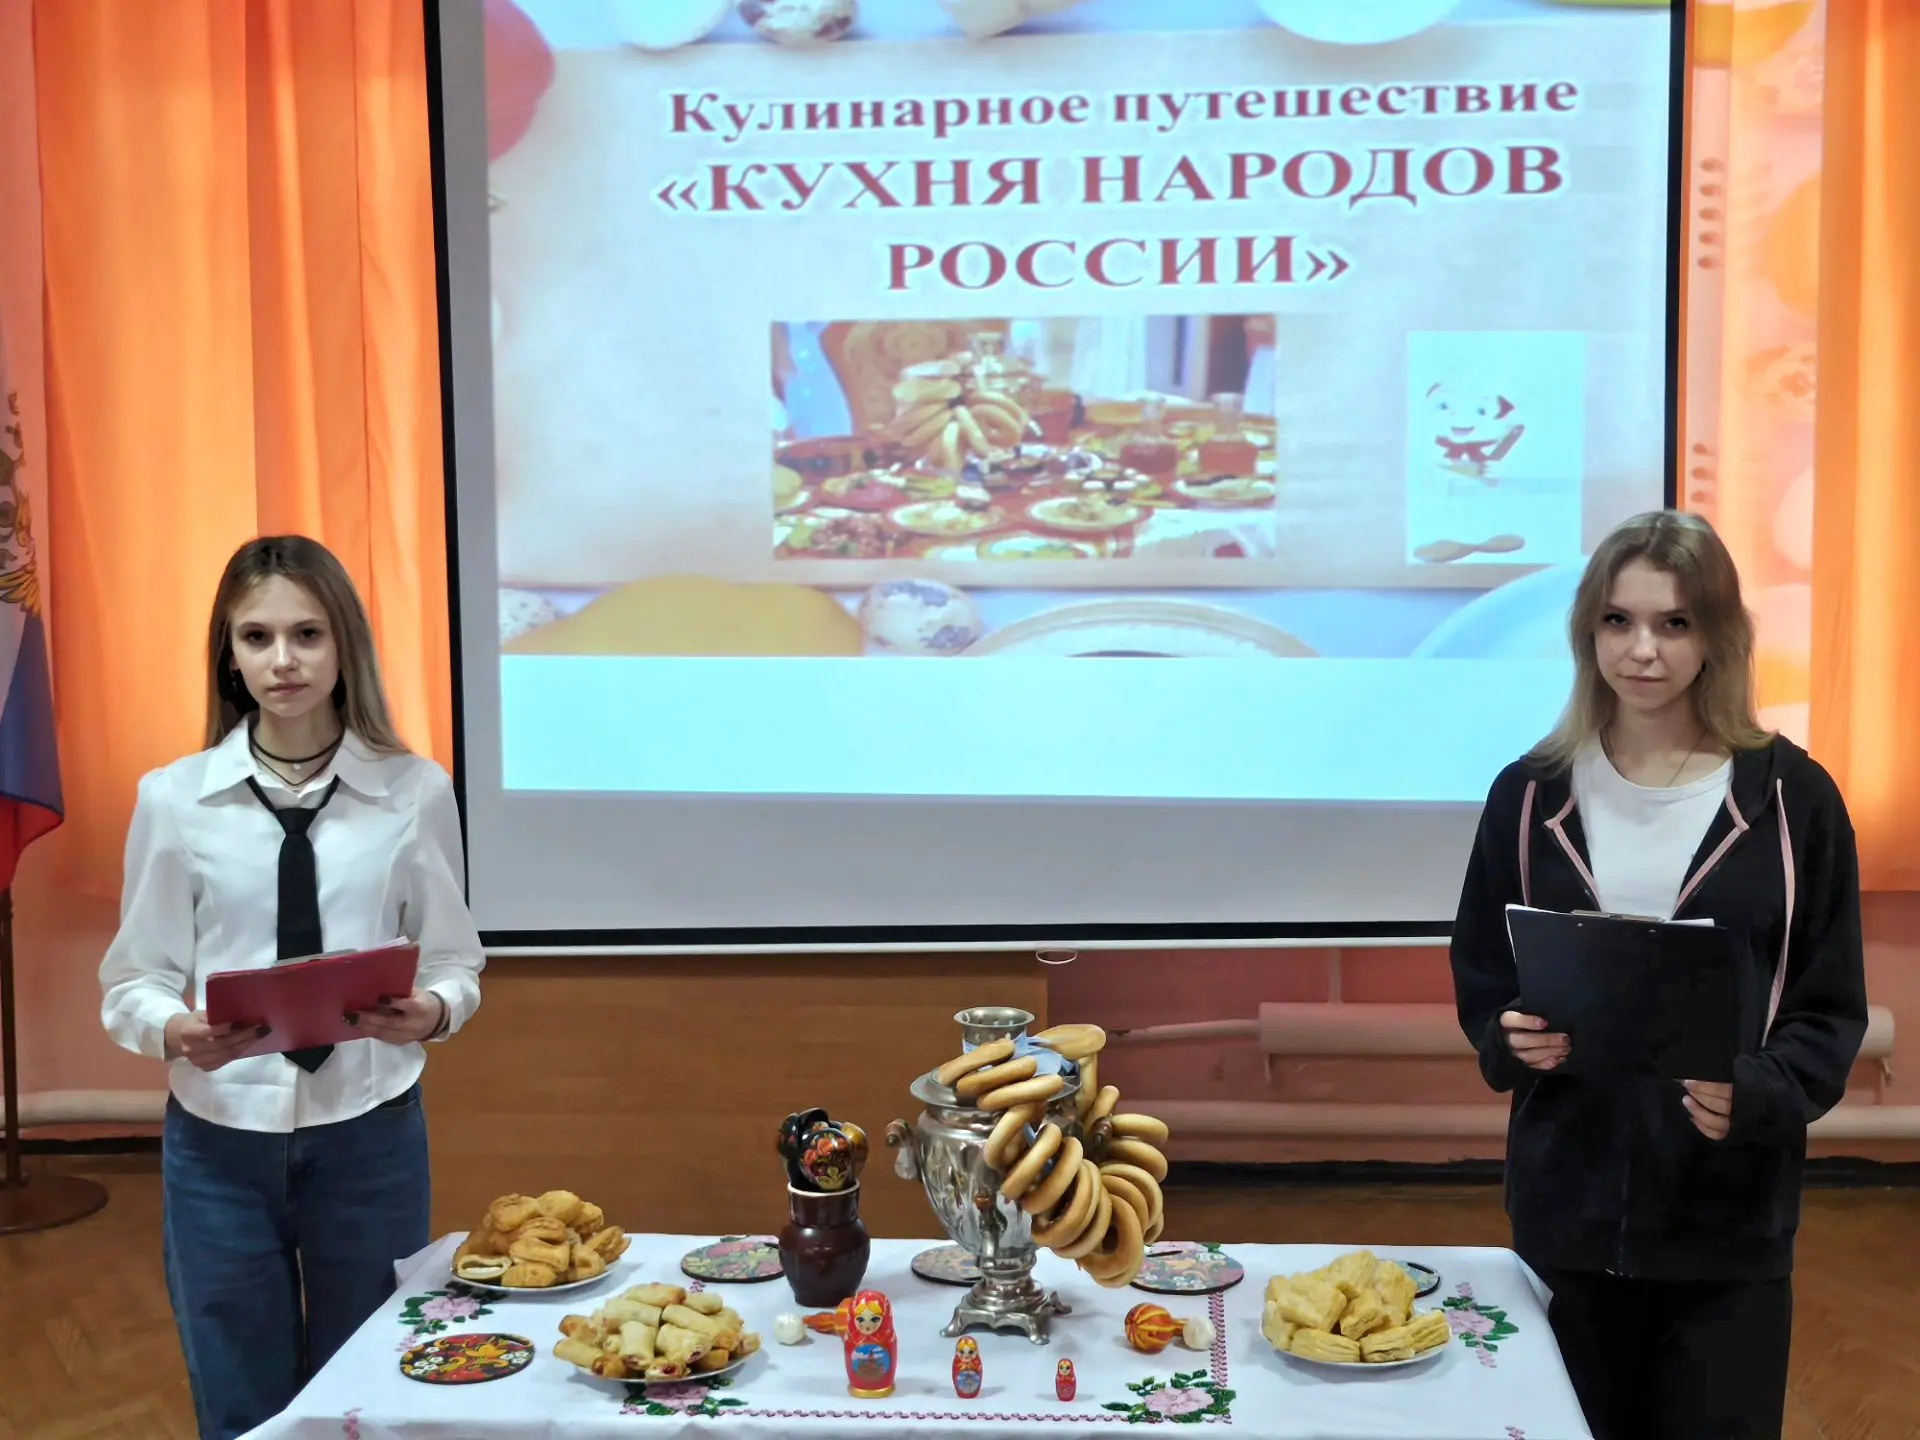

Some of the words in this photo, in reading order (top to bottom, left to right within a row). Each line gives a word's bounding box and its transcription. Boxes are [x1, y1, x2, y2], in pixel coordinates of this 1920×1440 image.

[670, 93, 1090, 141] Кулинарное
[1112, 80, 1578, 133] путешествие
[657, 158, 1040, 211] «КУХНЯ
[1082, 145, 1563, 208] НАРОДОВ
[888, 236, 1350, 290] РОССИИ»
